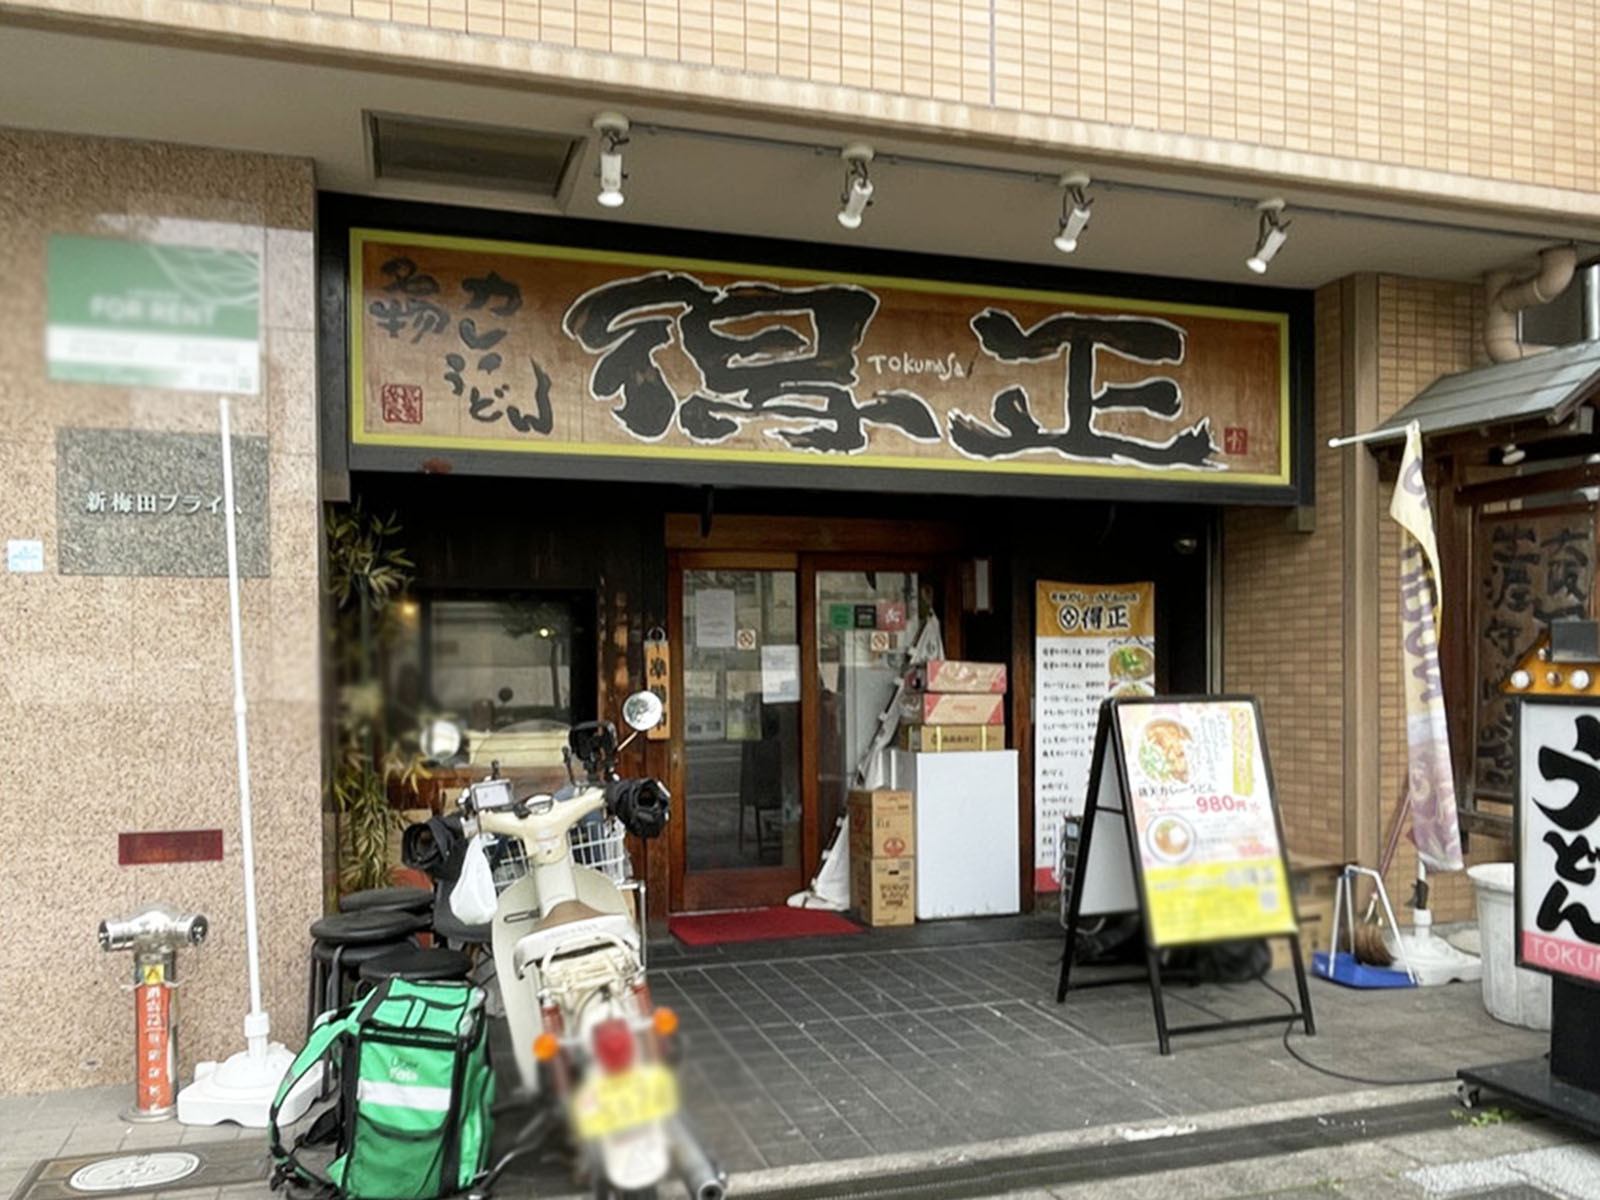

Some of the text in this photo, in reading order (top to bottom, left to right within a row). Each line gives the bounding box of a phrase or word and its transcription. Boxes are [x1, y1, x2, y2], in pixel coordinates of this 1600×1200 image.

[85, 489, 242, 515] 新梅田プライ
